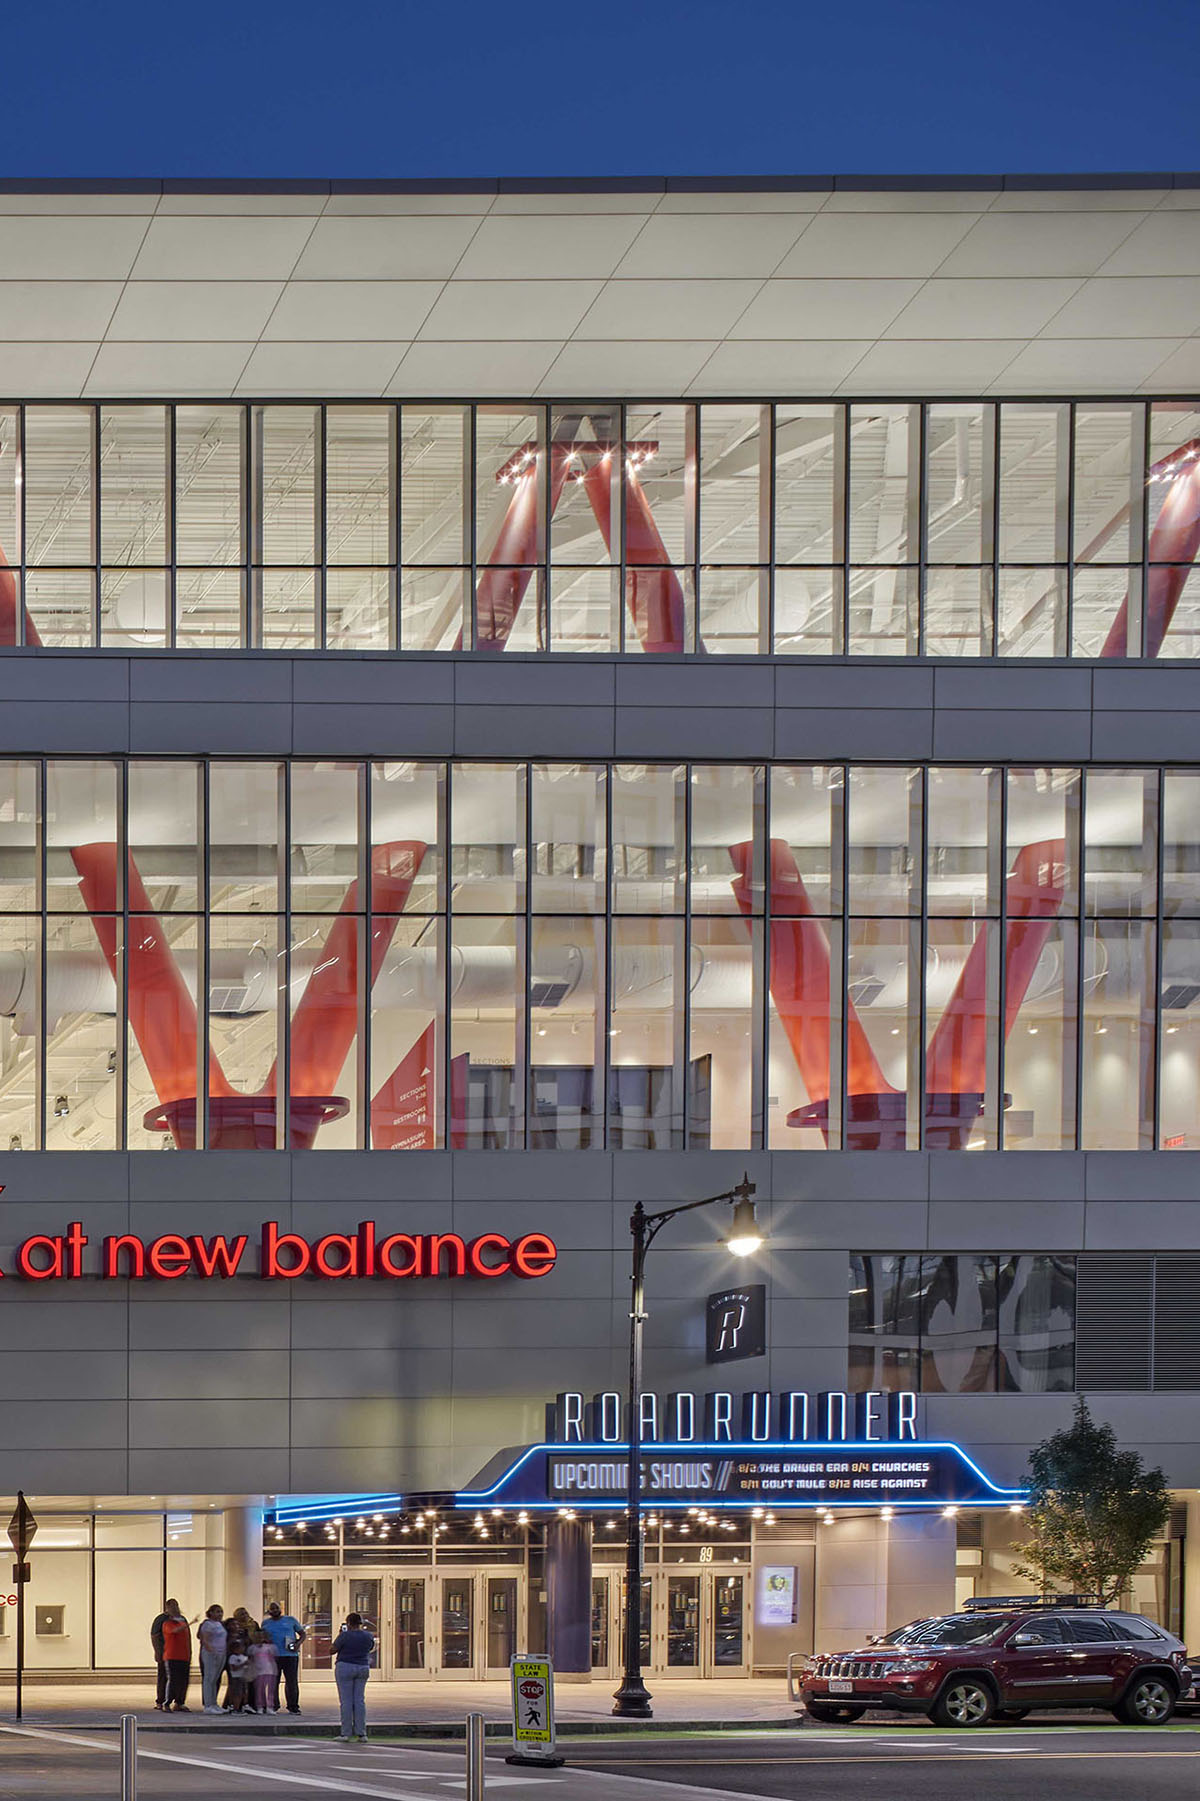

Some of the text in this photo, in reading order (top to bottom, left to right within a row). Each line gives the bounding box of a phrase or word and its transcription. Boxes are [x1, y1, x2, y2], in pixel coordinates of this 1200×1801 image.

[392, 1105, 426, 1125] RESTROOMS
[17, 1221, 88, 1279] at
[102, 1234, 248, 1279] new
[261, 1220, 557, 1280] balance
[564, 1392, 916, 1441] ROADRUNNER
[650, 1463, 714, 1489] SHOWS
[759, 1463, 780, 1473] THE
[826, 1463, 849, 1472] ERA
[851, 1462, 870, 1473] 8/4
[872, 1462, 930, 1472] CHURCHES
[796, 1480, 826, 1489] MULE
[852, 1480, 878, 1489] RISE
[881, 1479, 928, 1489] AGAINST
[700, 1546, 713, 1562] 89
[520, 1686, 544, 1694] STOP
